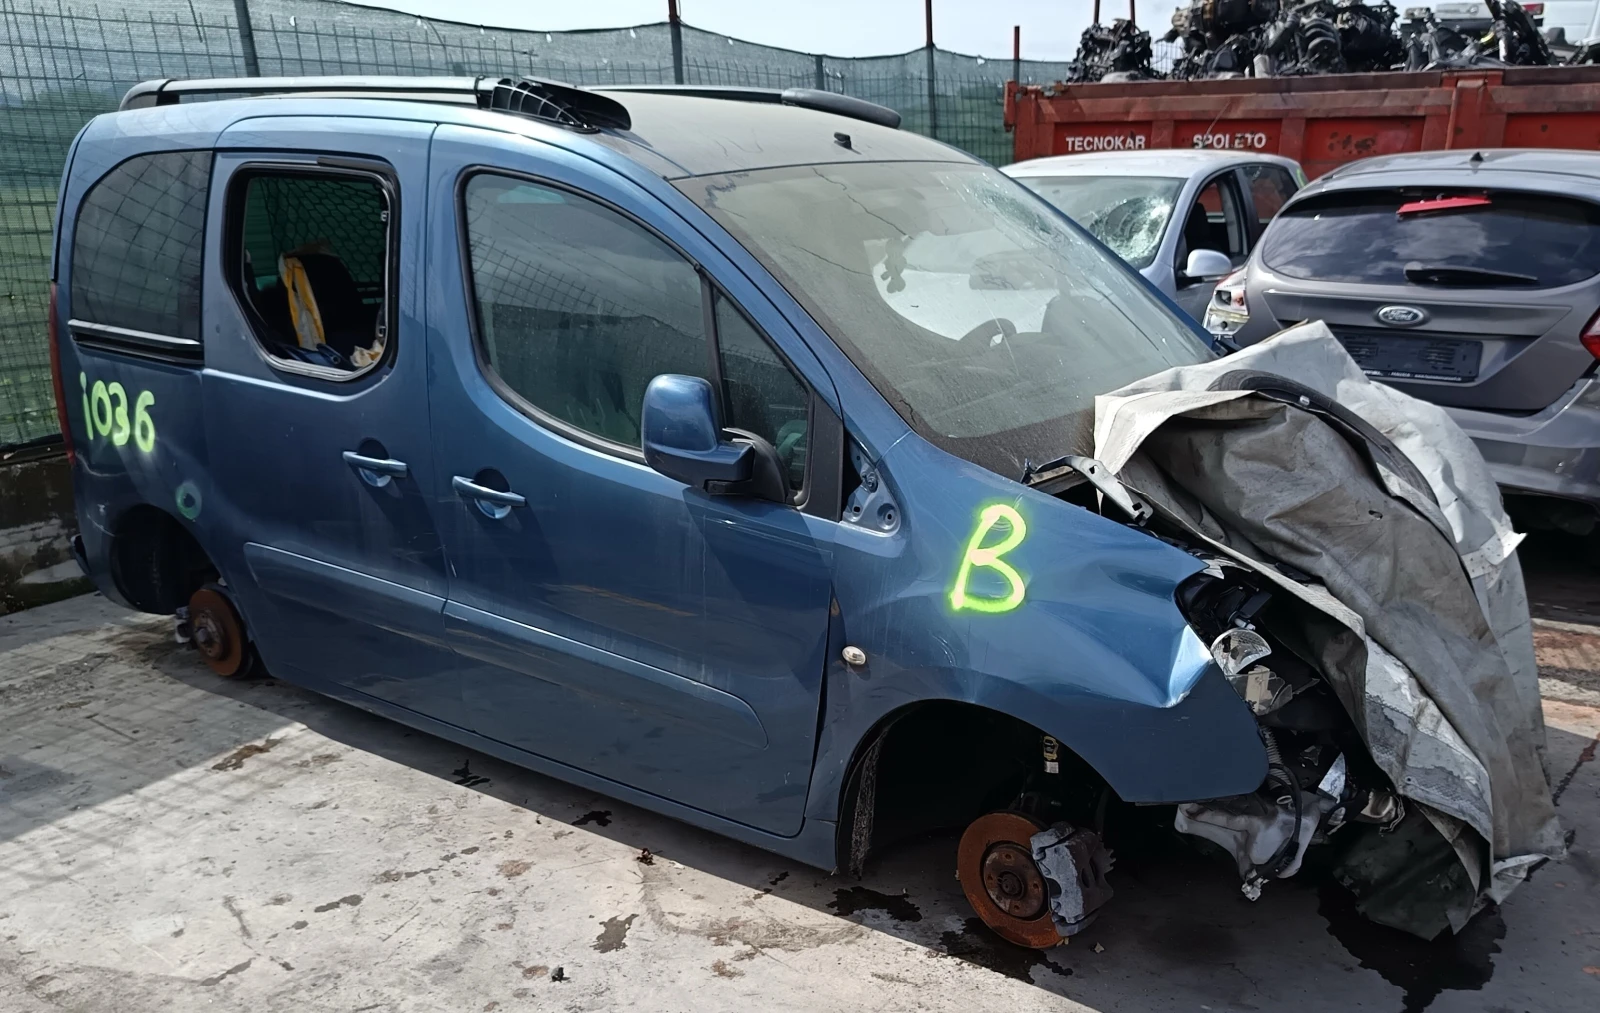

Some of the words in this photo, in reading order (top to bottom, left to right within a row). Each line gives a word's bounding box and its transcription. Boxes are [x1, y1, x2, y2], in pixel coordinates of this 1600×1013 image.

[1065, 134, 1147, 152] TECNOKAR
[1192, 132, 1267, 149] SPOLETO
[949, 503, 1027, 613] B
